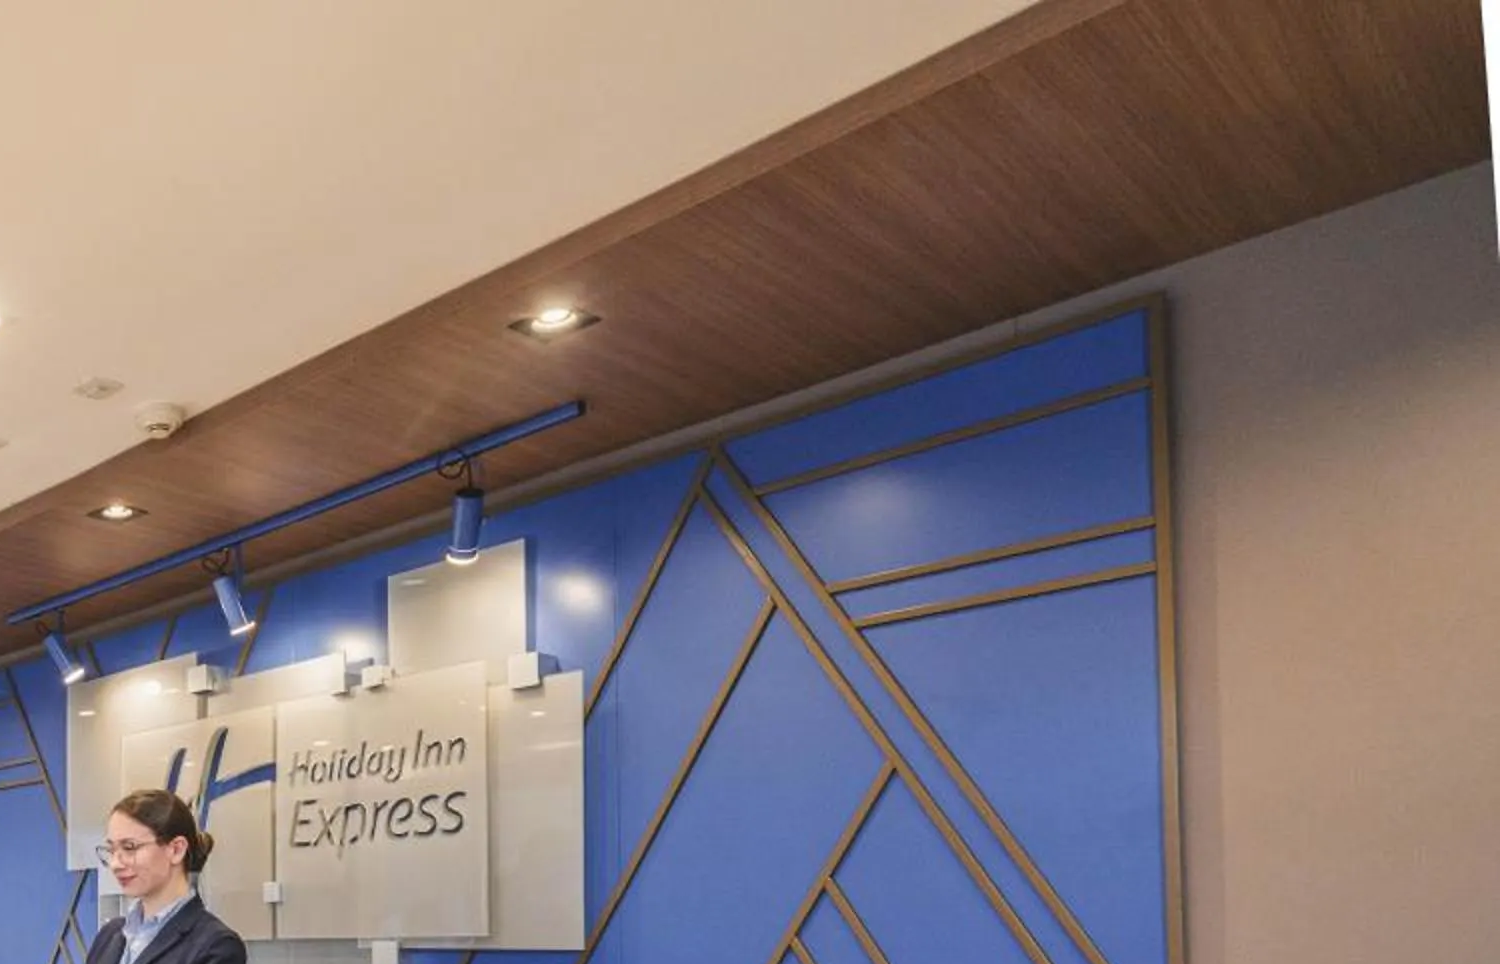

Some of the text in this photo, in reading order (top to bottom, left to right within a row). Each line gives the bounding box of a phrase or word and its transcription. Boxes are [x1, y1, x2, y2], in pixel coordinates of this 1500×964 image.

[289, 729, 466, 787] Holiday Inn
[289, 790, 467, 861] Express
